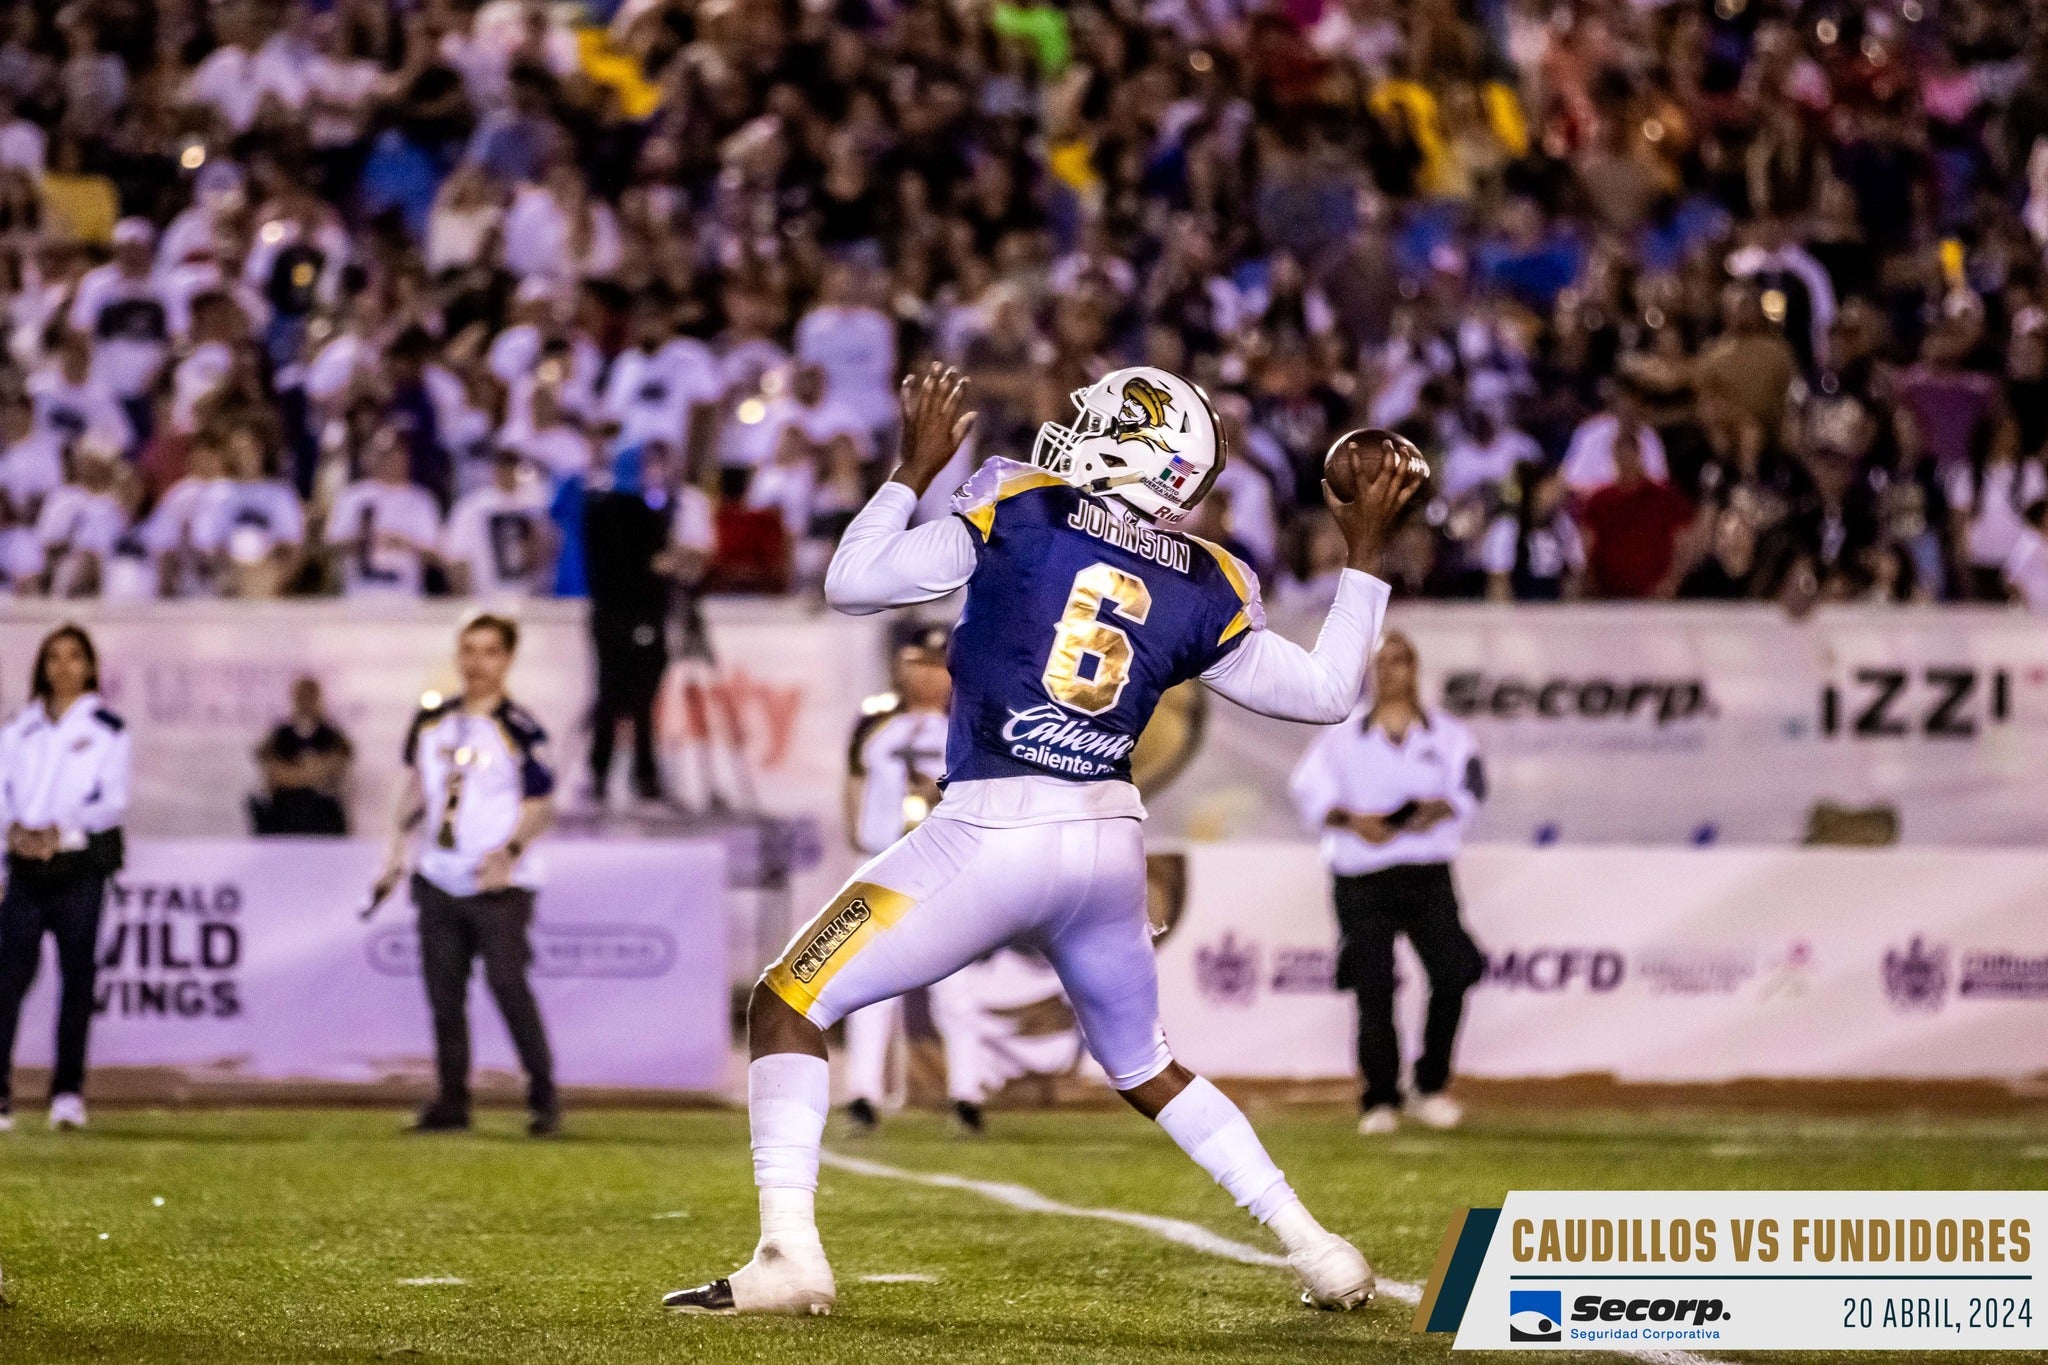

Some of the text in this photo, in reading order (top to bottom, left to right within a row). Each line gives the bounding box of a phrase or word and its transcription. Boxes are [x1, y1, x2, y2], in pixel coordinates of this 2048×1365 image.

[1067, 498, 1190, 574] JOHNSON
[1042, 562, 1152, 716] 6
[1002, 702, 1135, 760] Caliente
